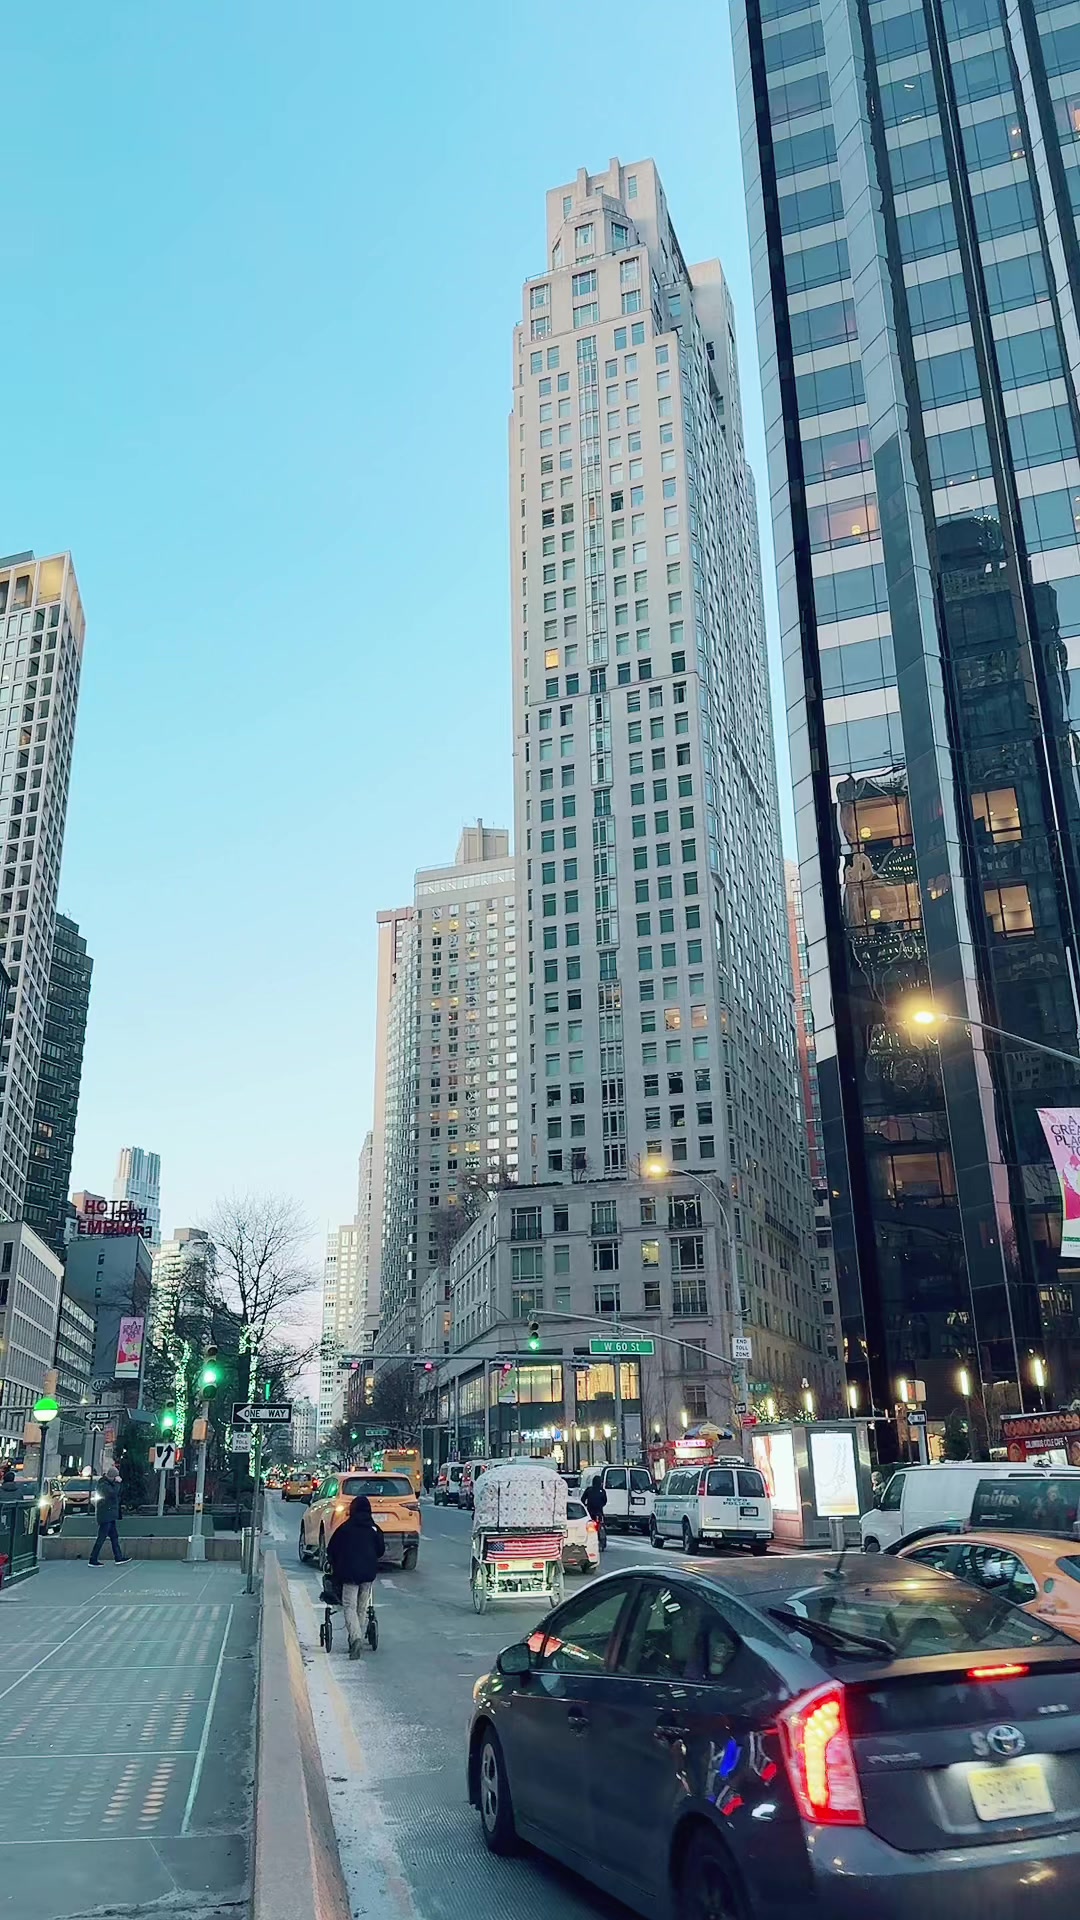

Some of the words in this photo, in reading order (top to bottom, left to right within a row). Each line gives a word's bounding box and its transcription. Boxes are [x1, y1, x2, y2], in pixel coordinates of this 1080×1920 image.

[1069, 1115, 1077, 1125] A
[85, 1200, 137, 1214] HOTEL
[603, 1342, 612, 1351] W
[616, 1342, 628, 1351] 60
[630, 1342, 640, 1351] St
[244, 1409, 261, 1418] ONE
[268, 1409, 286, 1418] WAY
